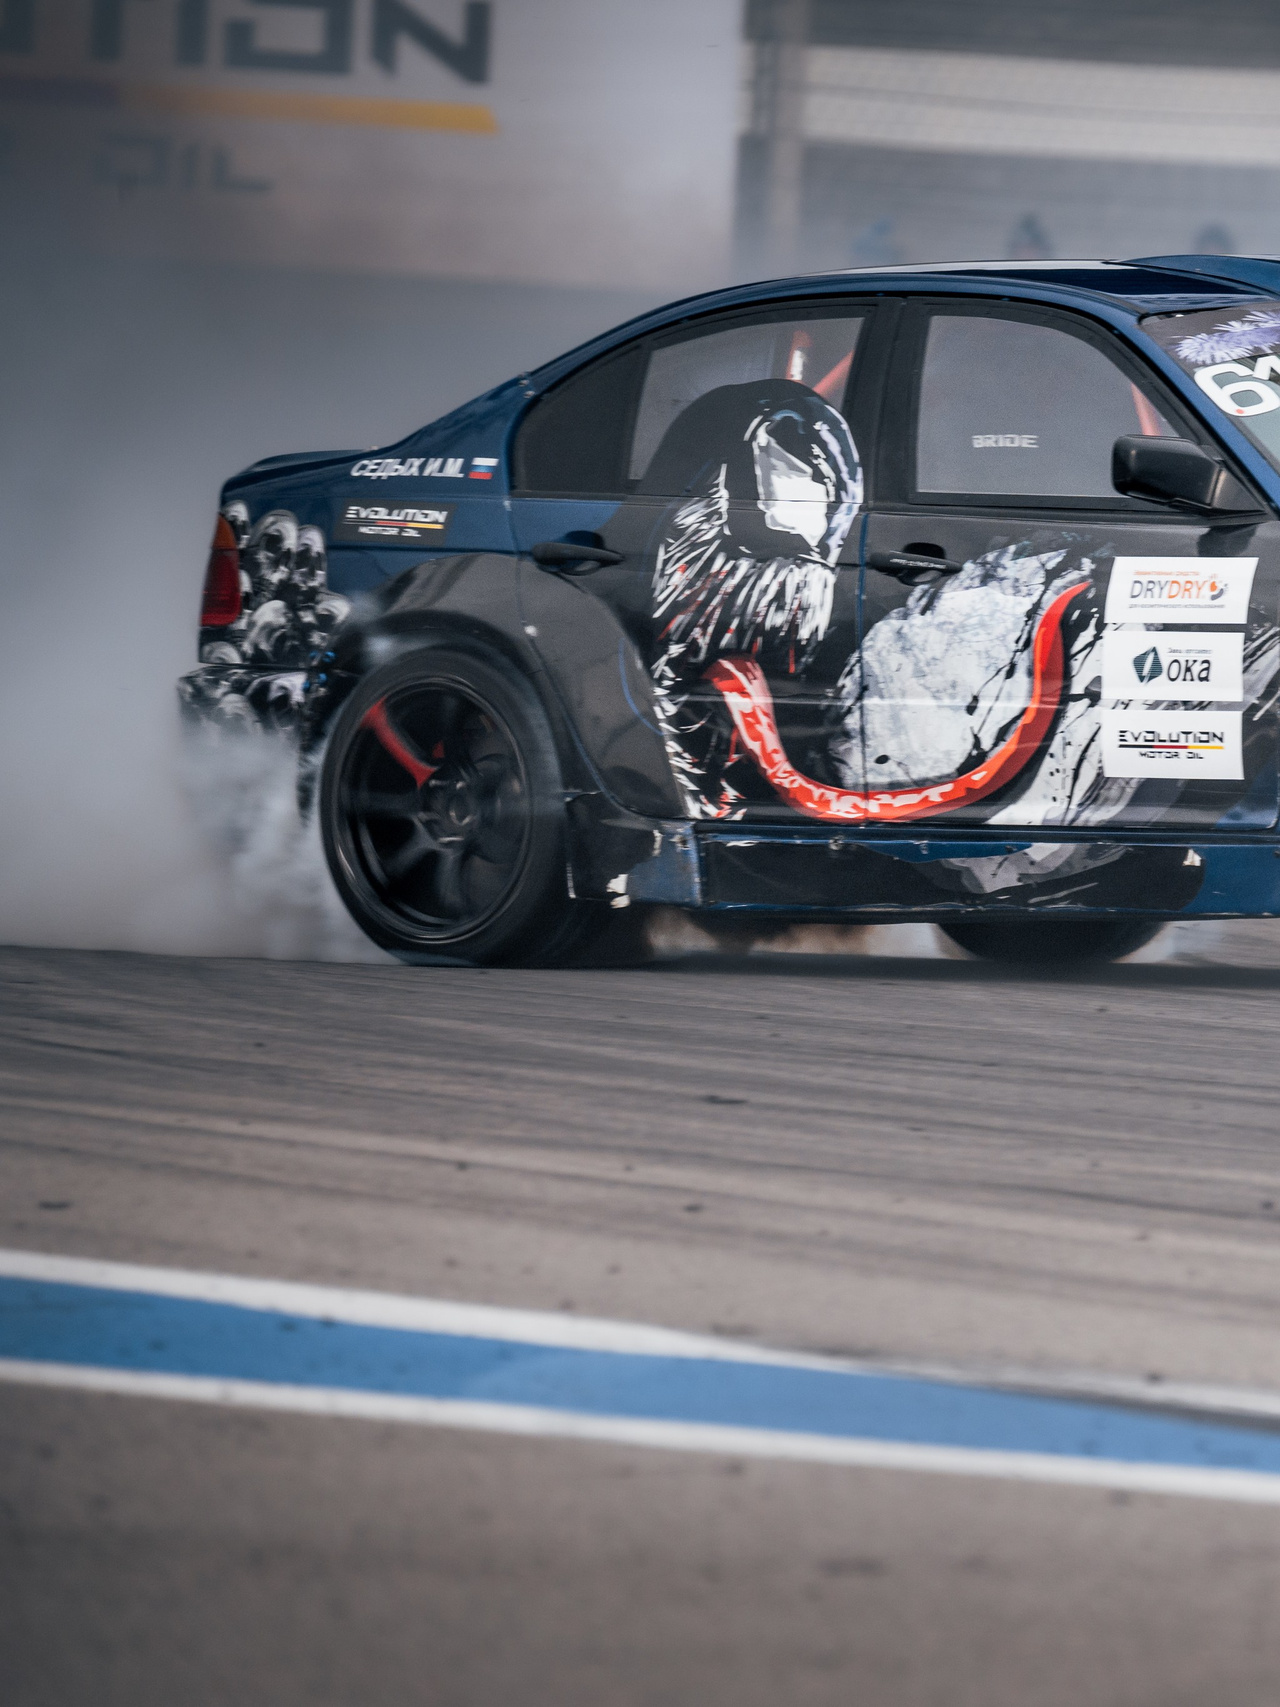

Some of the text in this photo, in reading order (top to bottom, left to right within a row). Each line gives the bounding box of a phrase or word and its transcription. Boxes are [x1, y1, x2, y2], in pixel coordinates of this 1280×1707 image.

[972, 434, 1039, 448] BRIDE
[350, 458, 425, 479] СЕДЫХ
[345, 506, 448, 523] EVOLUTION
[358, 526, 421, 537] MOTOR OIL
[1130, 579, 1208, 599] DRYDRY
[1118, 730, 1224, 743] EVOLUTION
[1138, 751, 1204, 760] MOTOR OIL
